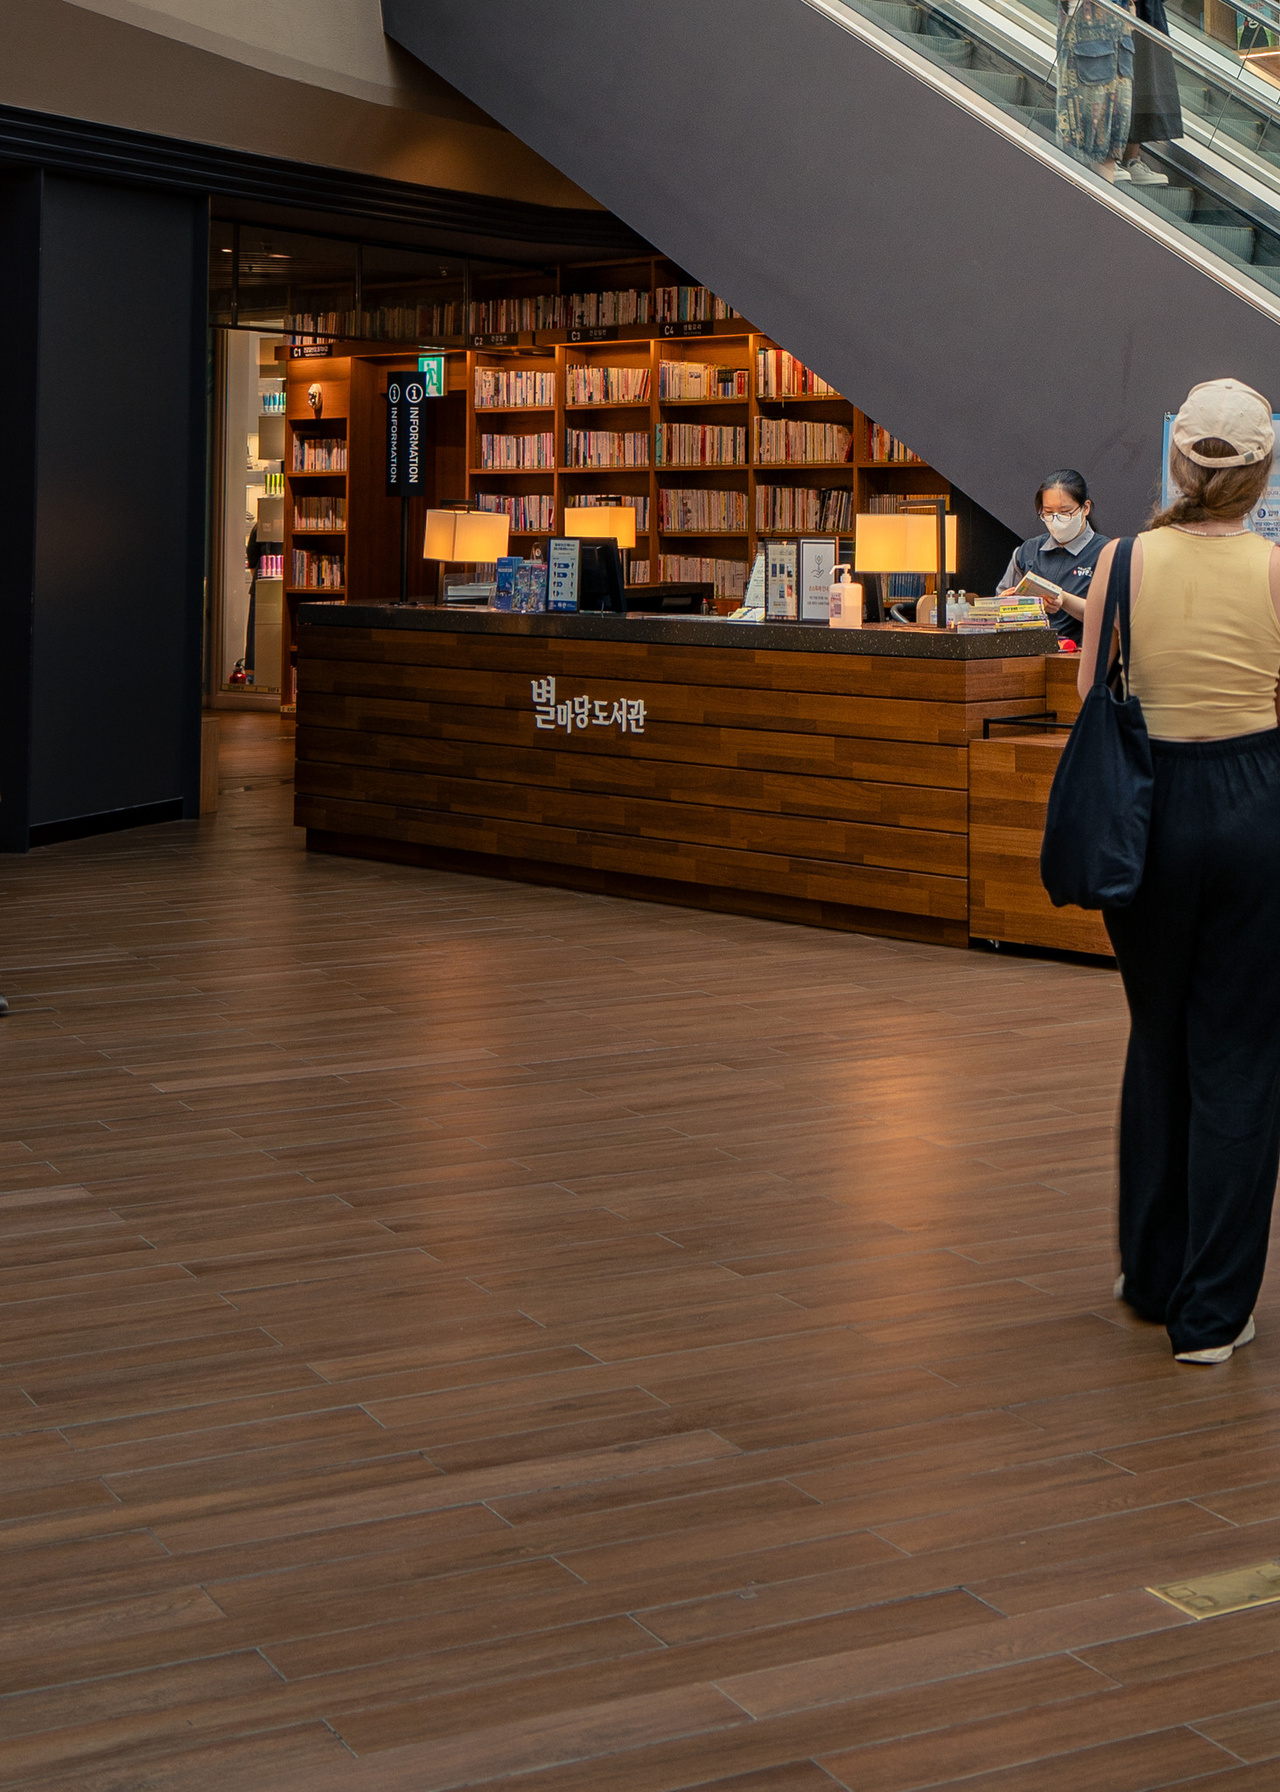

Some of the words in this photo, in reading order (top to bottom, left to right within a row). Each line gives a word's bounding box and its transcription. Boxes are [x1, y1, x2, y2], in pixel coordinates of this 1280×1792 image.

[664, 326, 674, 335] C4
[572, 331, 581, 341] C3
[474, 337, 483, 346] C2
[294, 348, 301, 357] C1
[408, 407, 418, 483] INFORMATION
